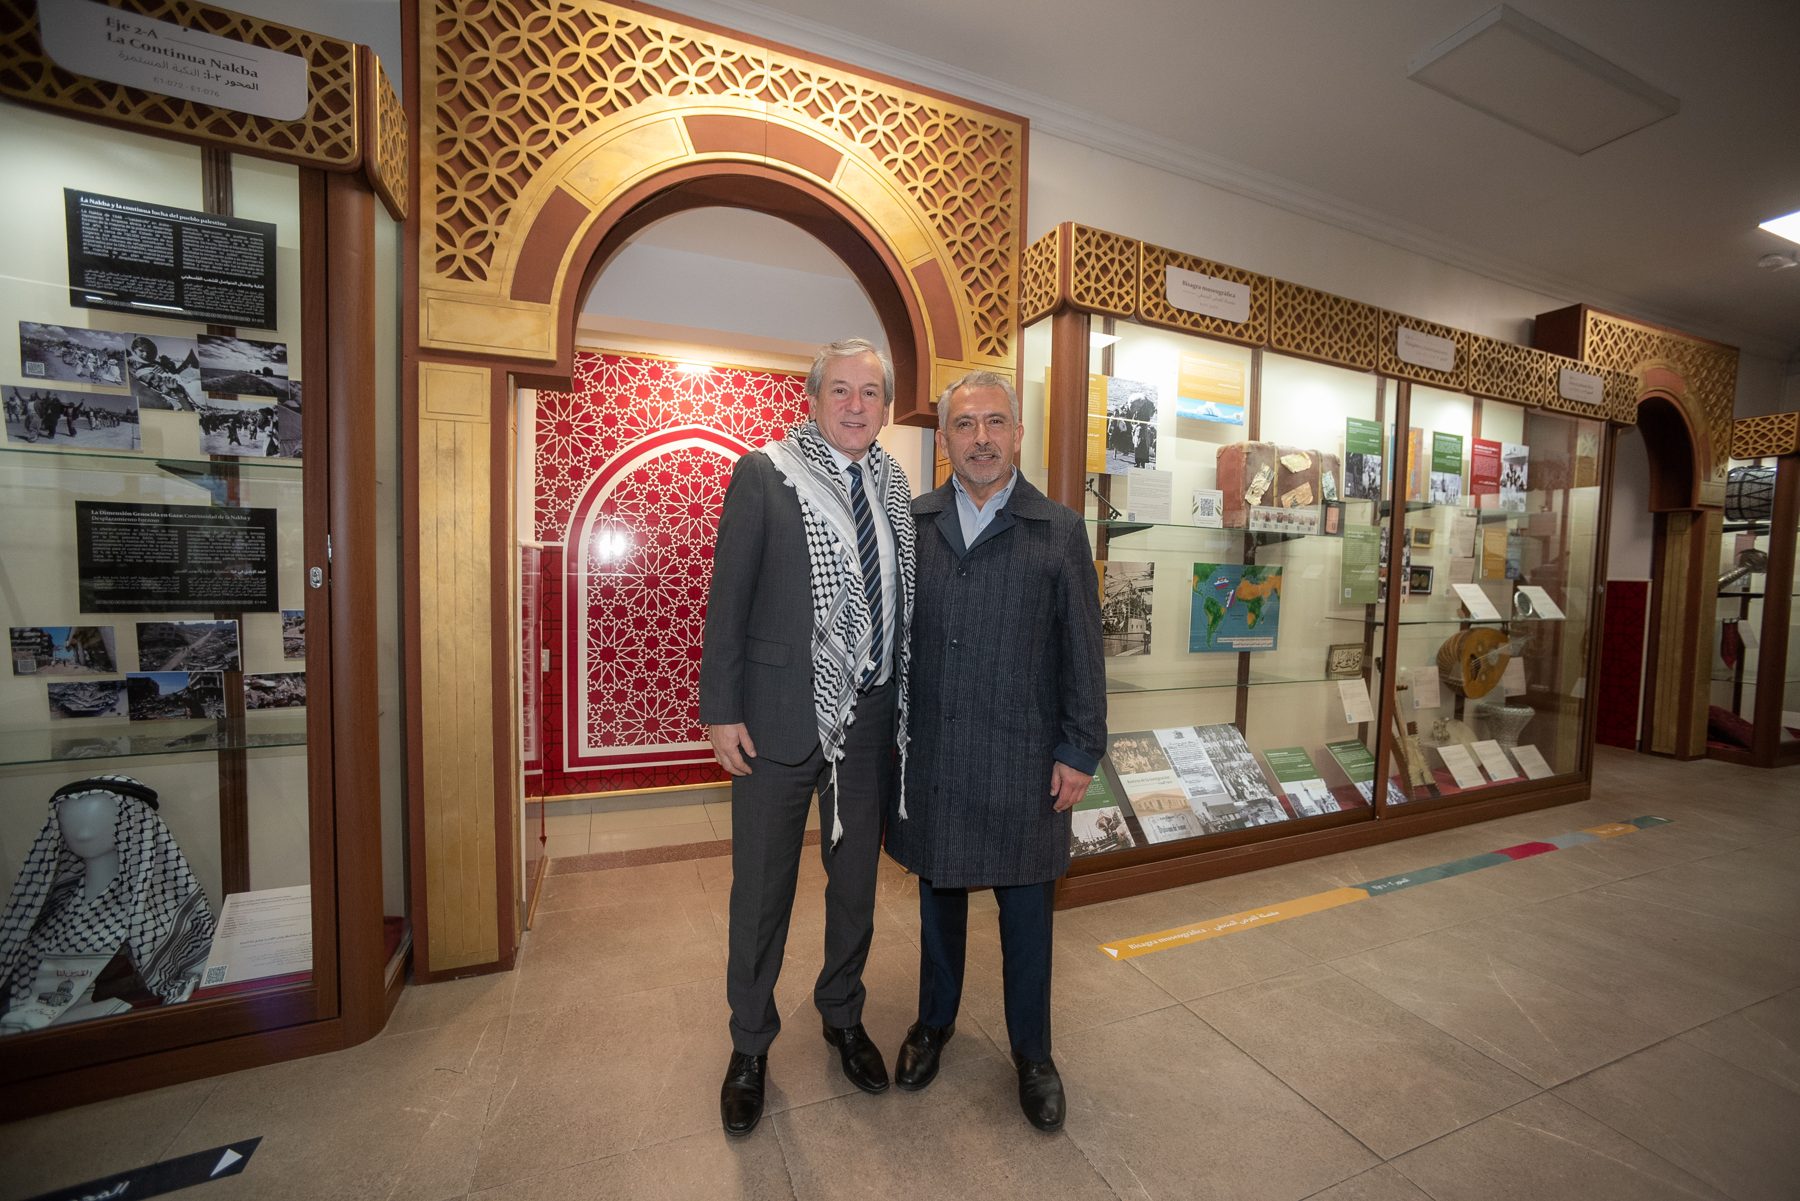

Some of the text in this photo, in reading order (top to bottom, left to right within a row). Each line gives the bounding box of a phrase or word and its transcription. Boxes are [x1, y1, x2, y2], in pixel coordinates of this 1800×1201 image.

[106, 17, 159, 40] Eje 2-A
[106, 32, 258, 79] La Continua Nakba
[224, 78, 259, 92] المحور
[80, 196, 89, 204] La
[89, 198, 111, 208] Nakba
